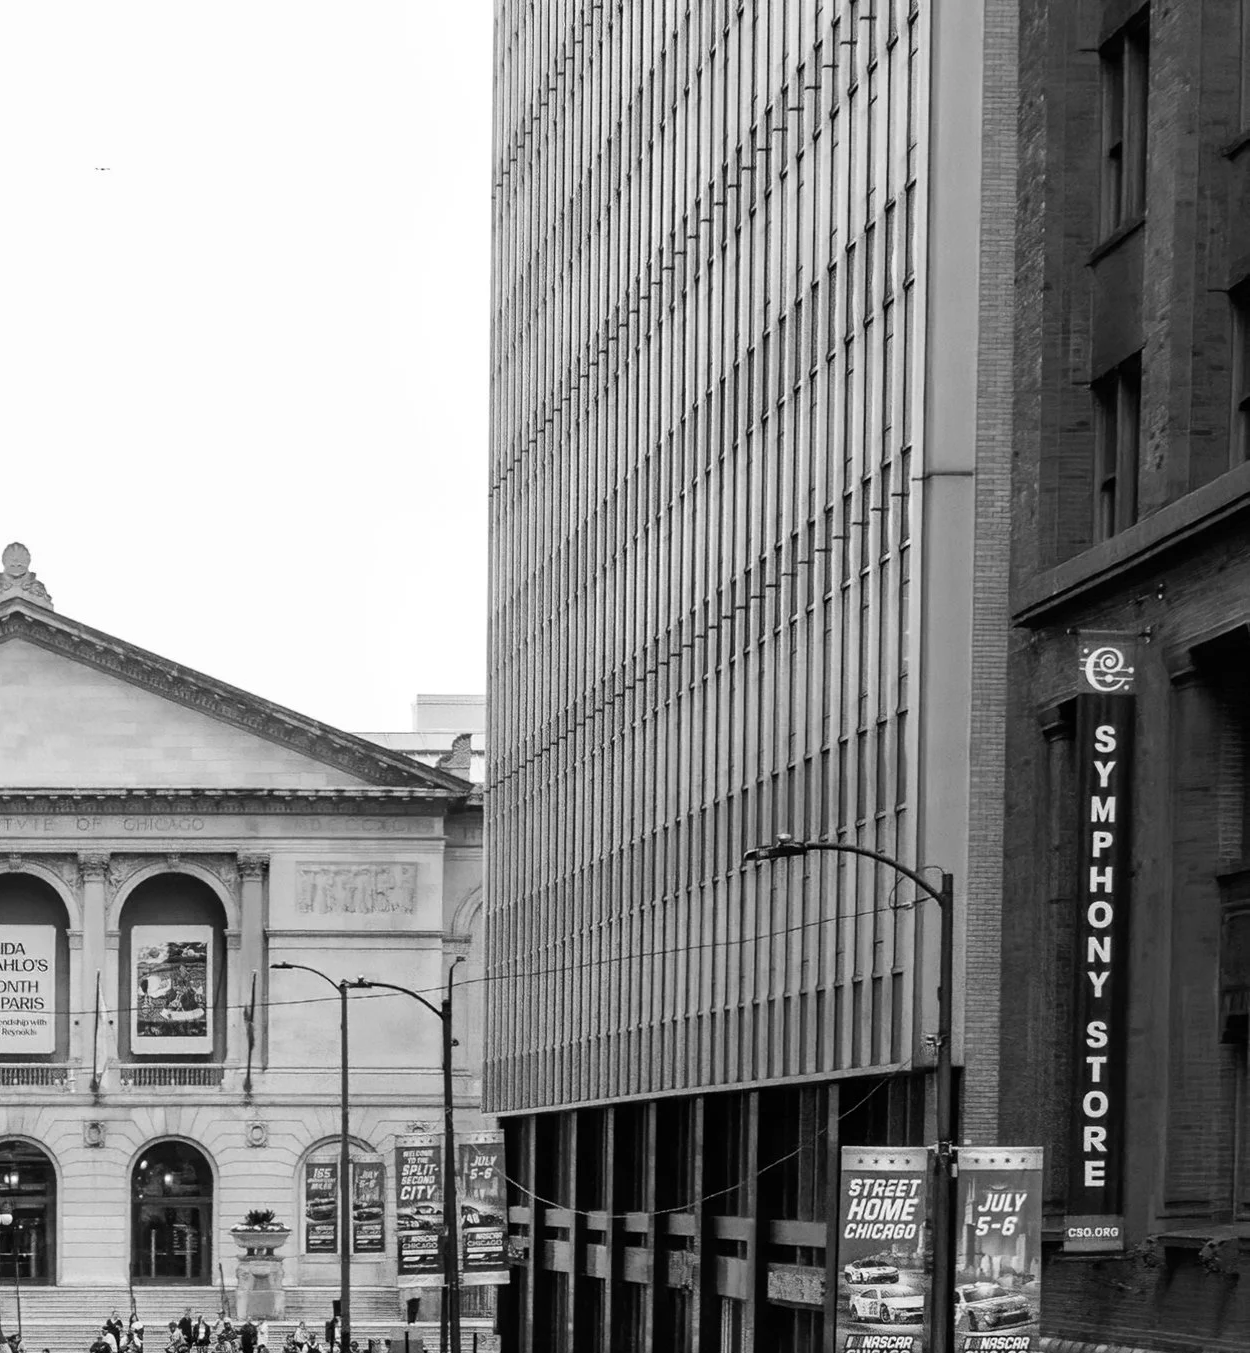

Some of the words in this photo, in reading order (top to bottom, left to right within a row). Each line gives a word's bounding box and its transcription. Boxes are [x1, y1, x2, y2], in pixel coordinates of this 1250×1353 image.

[76, 818, 100, 831] OF
[124, 818, 204, 831] CHICAGO
[1086, 725, 1116, 999] SYMPHONY
[1, 997, 45, 1010] PARIS
[1083, 1020, 1109, 1188] STORE
[400, 1185, 436, 1200] CITY
[848, 1179, 921, 1197] STREET
[847, 1199, 919, 1221] HOME
[978, 1193, 1027, 1212] JULY
[844, 1223, 916, 1239] CHICAGO
[975, 1216, 1018, 1236] 5-6
[1068, 1226, 1120, 1240] CSO.ORG
